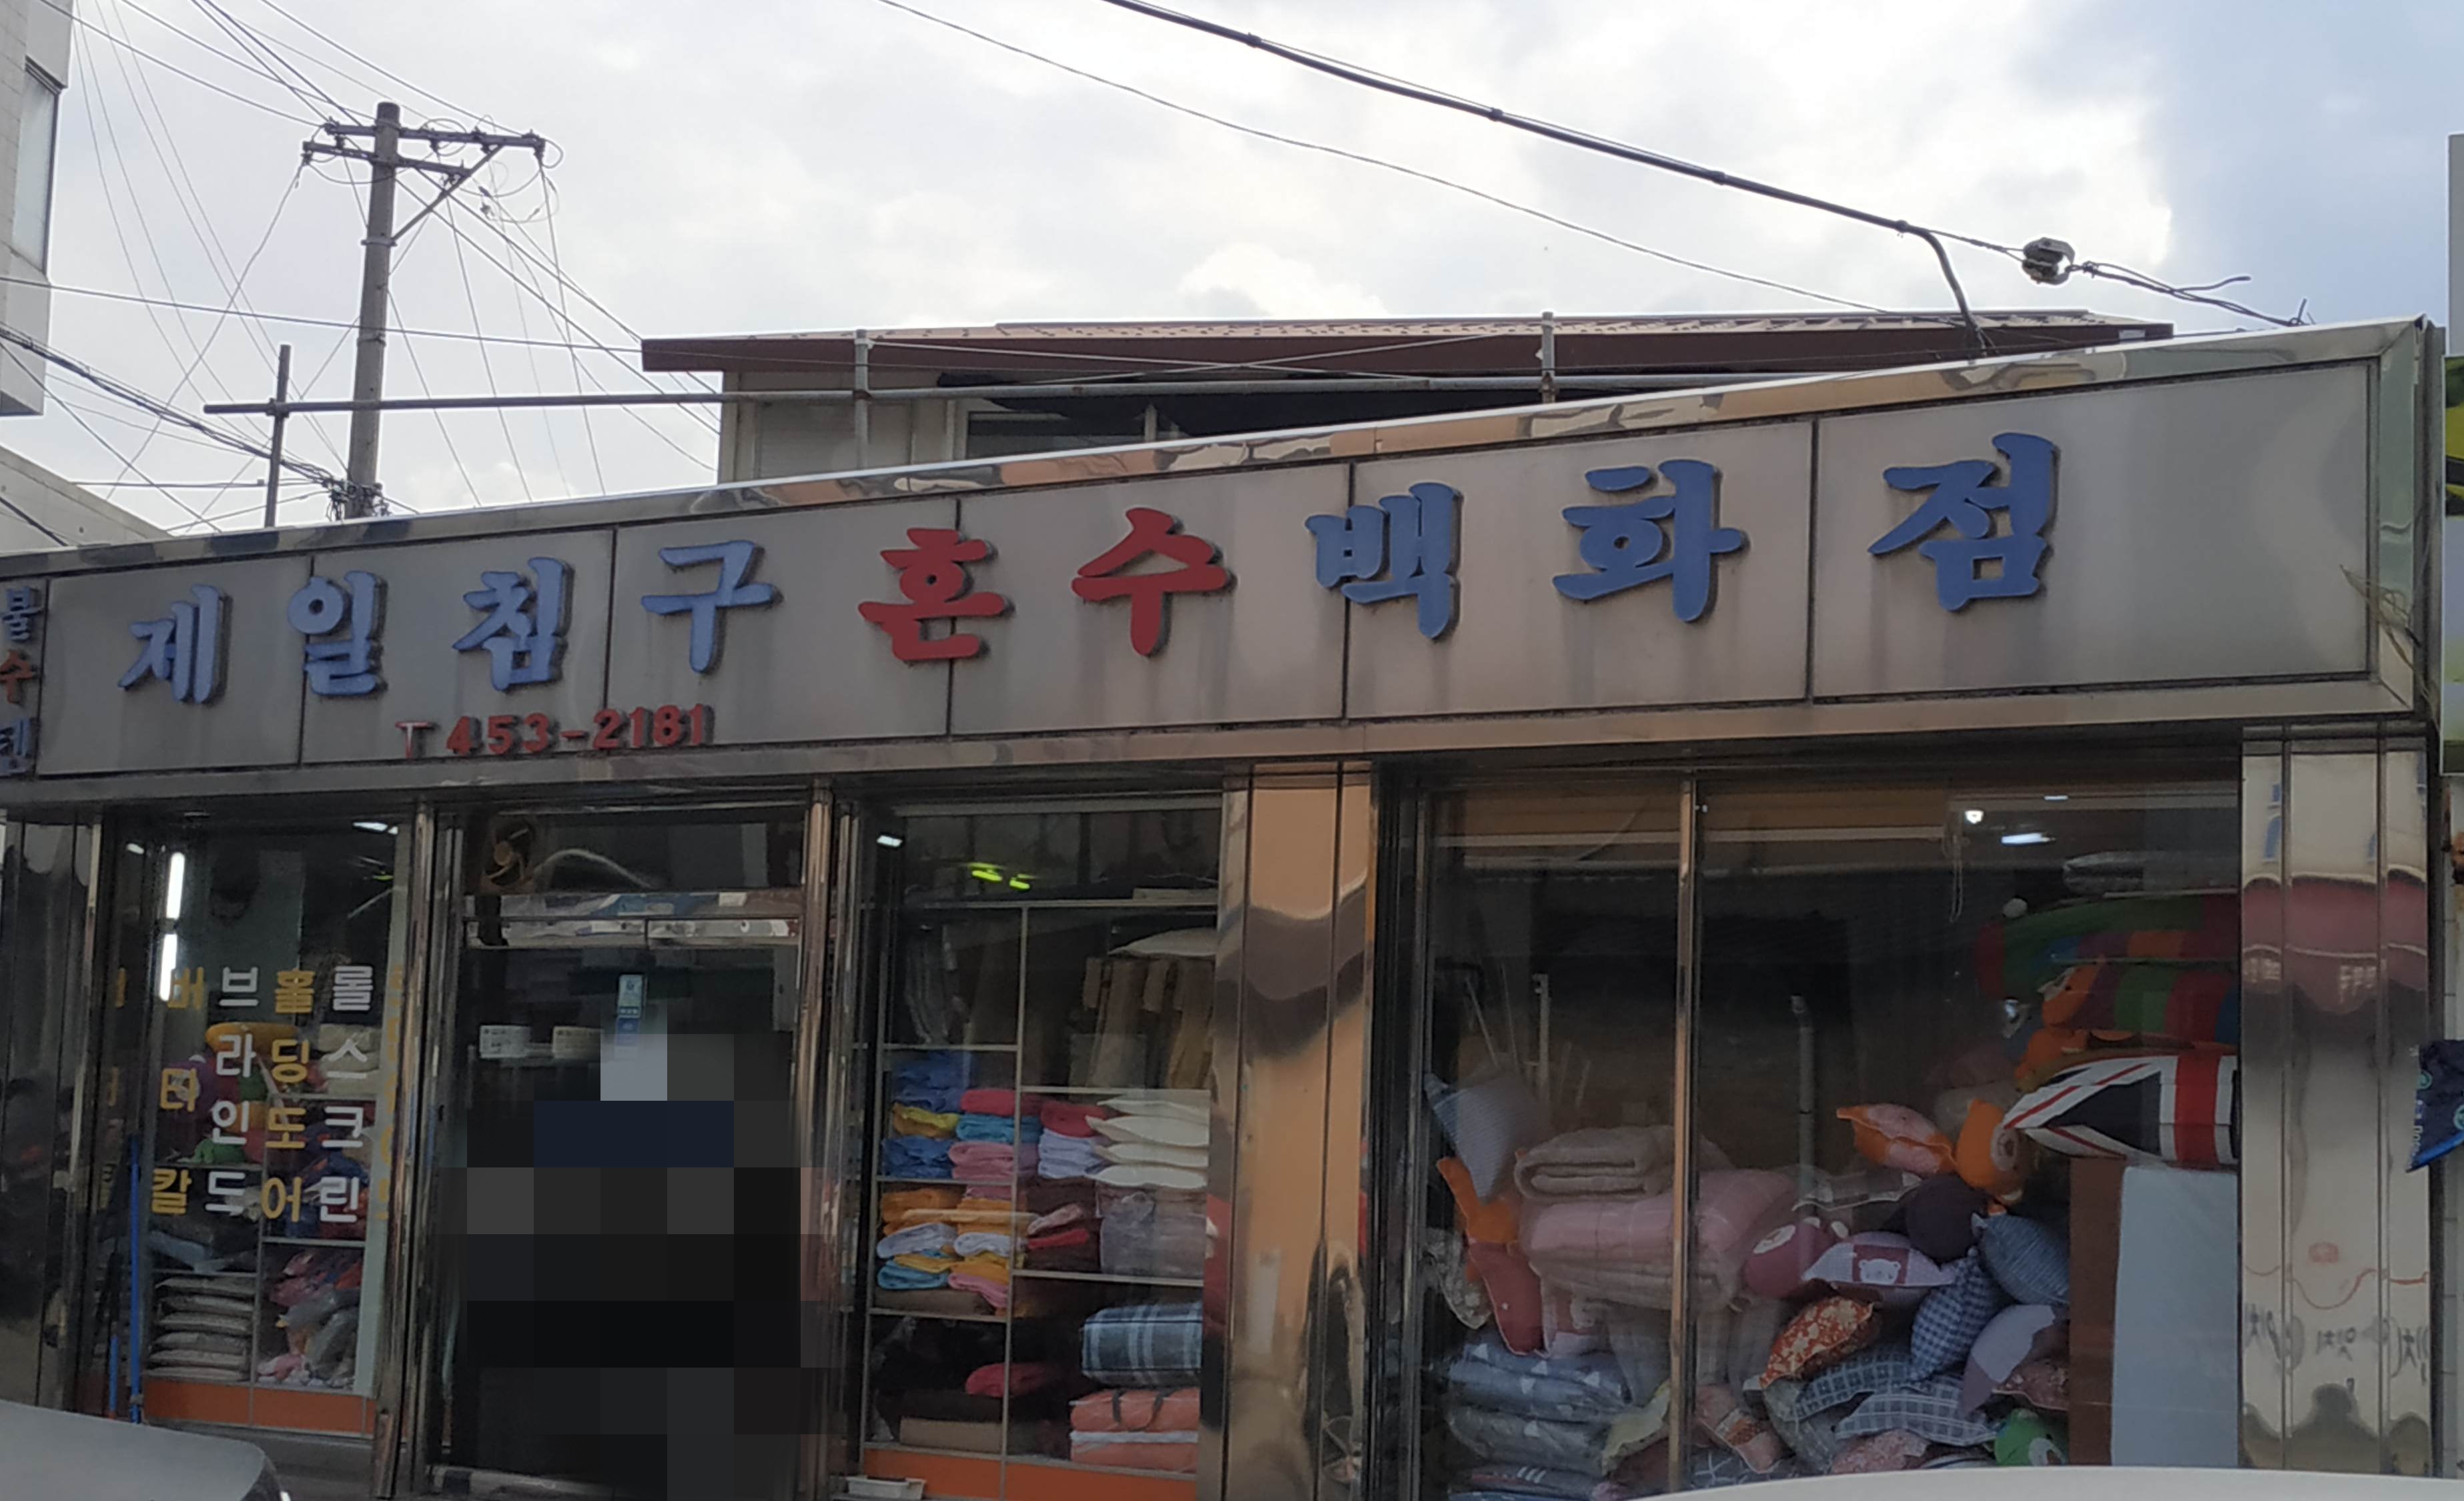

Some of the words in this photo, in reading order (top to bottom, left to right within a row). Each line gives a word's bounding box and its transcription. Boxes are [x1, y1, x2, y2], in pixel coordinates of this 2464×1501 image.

[117, 540, 775, 704] 제일침구
[858, 508, 1231, 660] 혼수
[1304, 432, 2057, 639] 백화점
[446, 704, 703, 755] 453-2181
